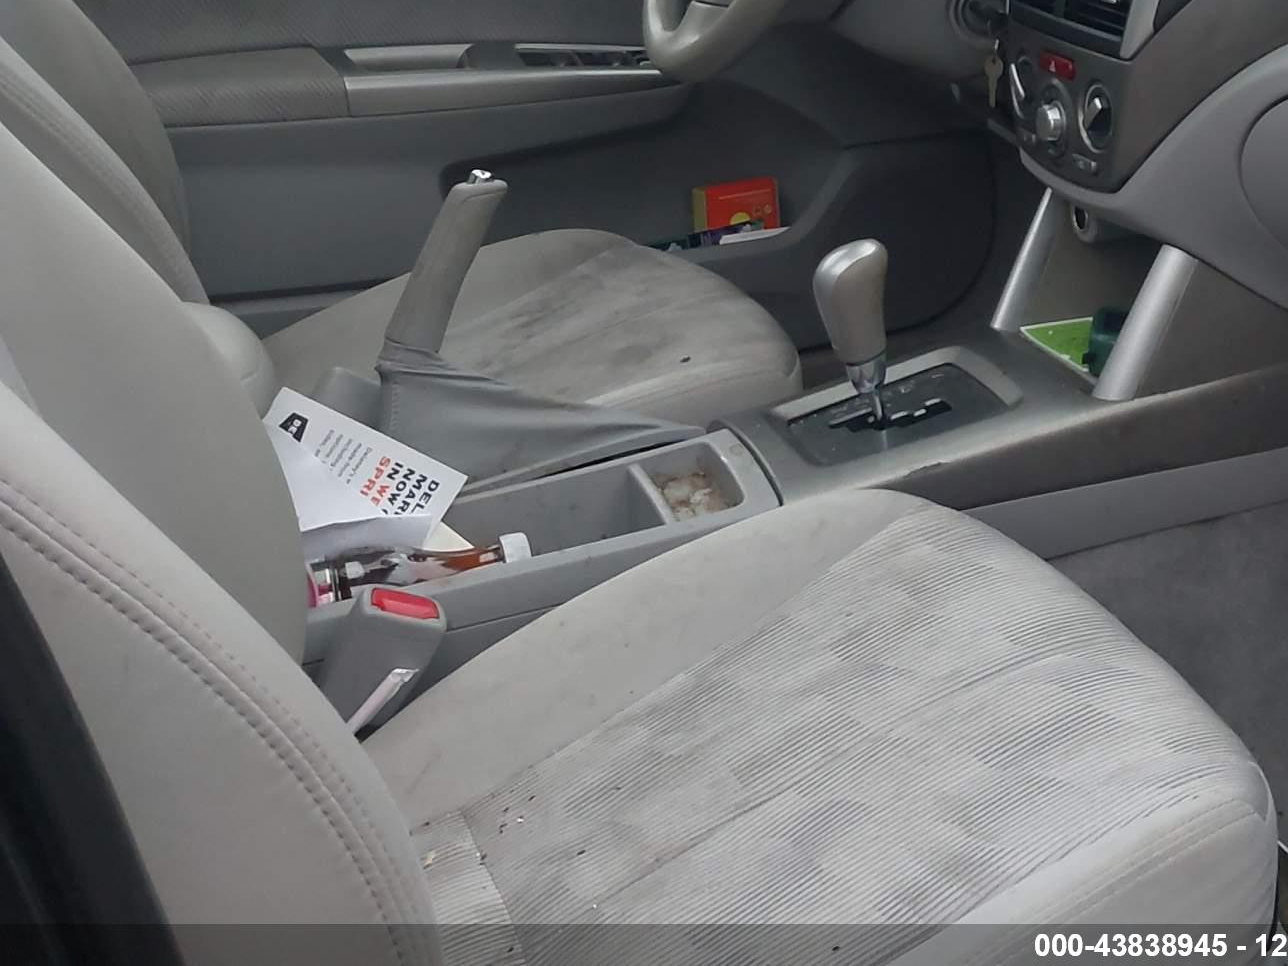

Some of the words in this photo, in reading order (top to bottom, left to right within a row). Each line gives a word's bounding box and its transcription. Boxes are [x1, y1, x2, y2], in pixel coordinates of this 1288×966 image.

[360, 456, 391, 497] SPRI
[386, 461, 404, 480] IN
[387, 467, 416, 506] NOW
[411, 479, 440, 513] DEL
